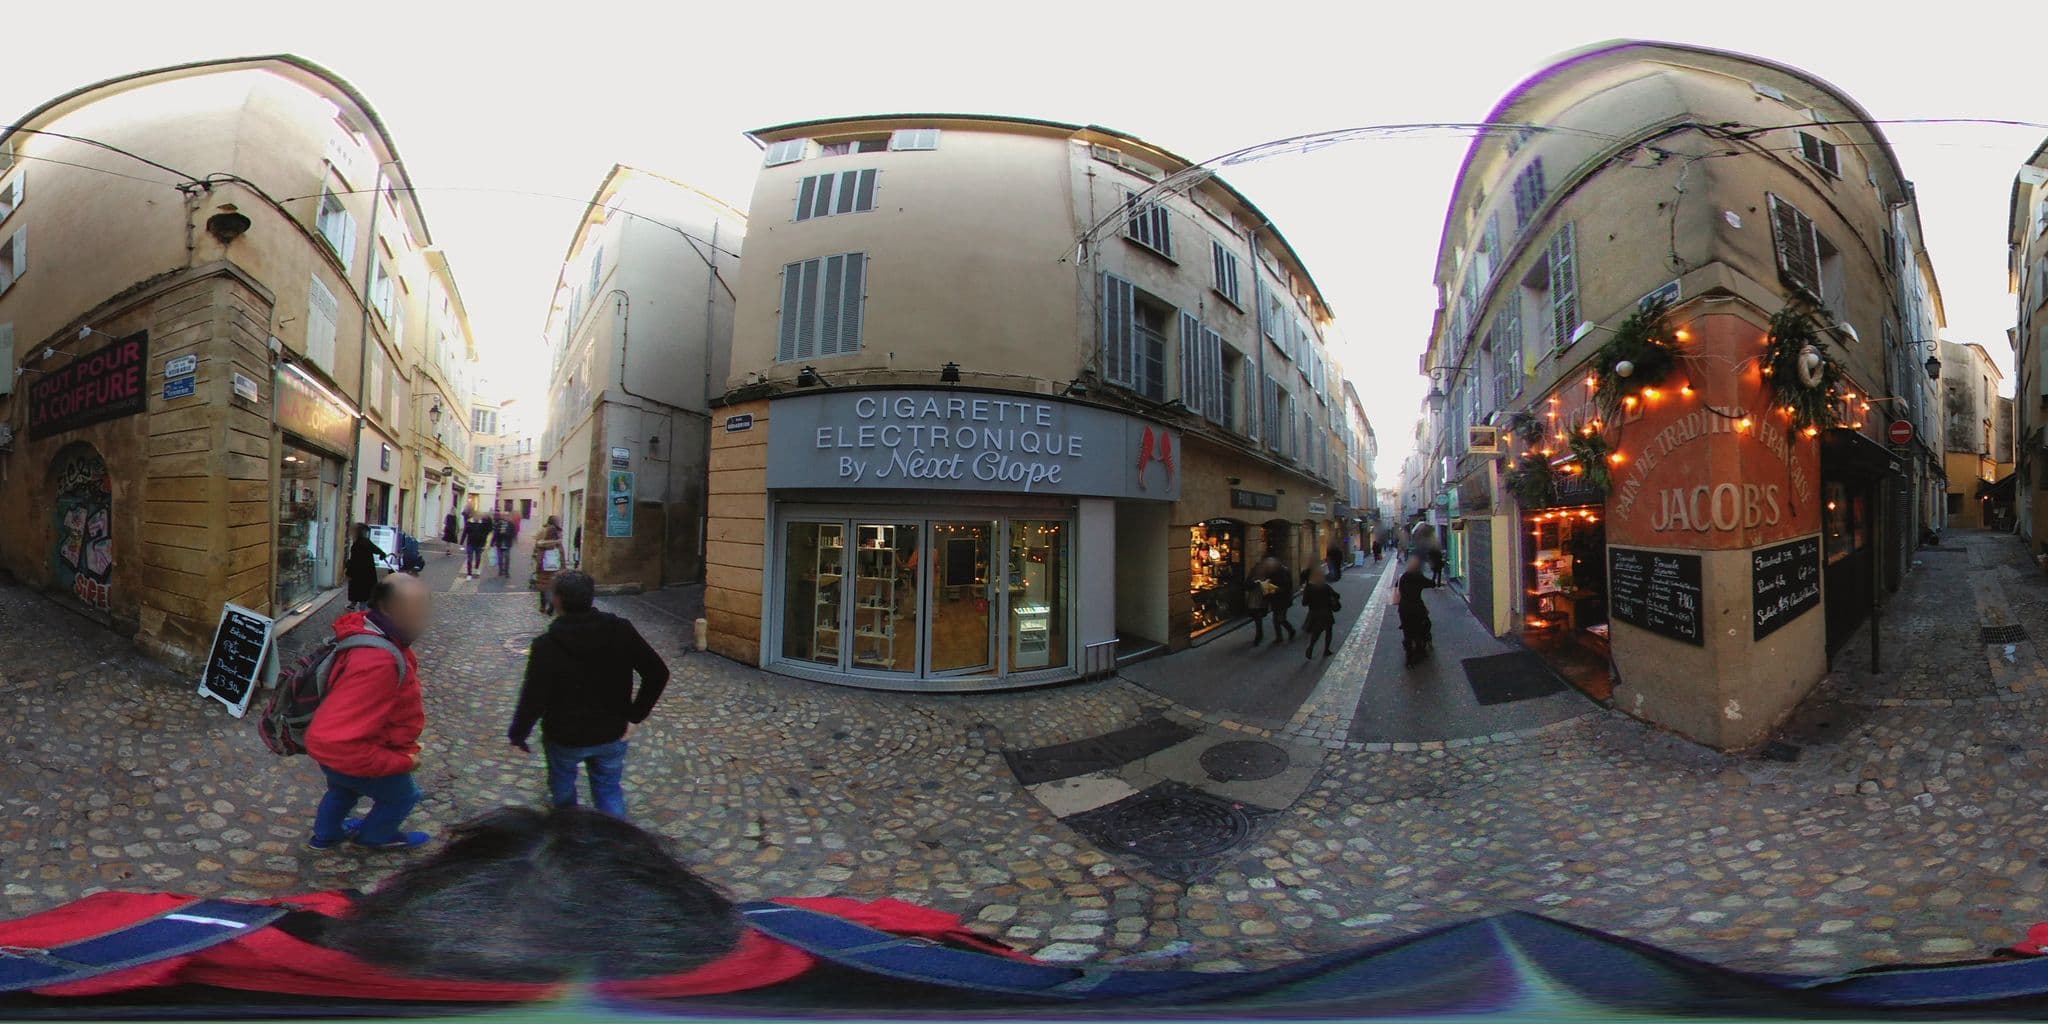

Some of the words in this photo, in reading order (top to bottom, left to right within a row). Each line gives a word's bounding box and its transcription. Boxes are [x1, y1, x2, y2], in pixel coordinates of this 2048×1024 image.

[33, 368, 71, 402] TOUT
[77, 341, 139, 385] POUR
[50, 366, 139, 419] COIFFURE
[855, 397, 1051, 427] CIGARETTE
[816, 425, 1083, 457] ELECTRONIQUE
[839, 456, 867, 482] By
[875, 448, 964, 480] Next
[972, 451, 1062, 493] Clope
[1616, 473, 1641, 520] PAIN
[1634, 447, 1658, 477] DE
[1651, 483, 1780, 532] JACOB'S
